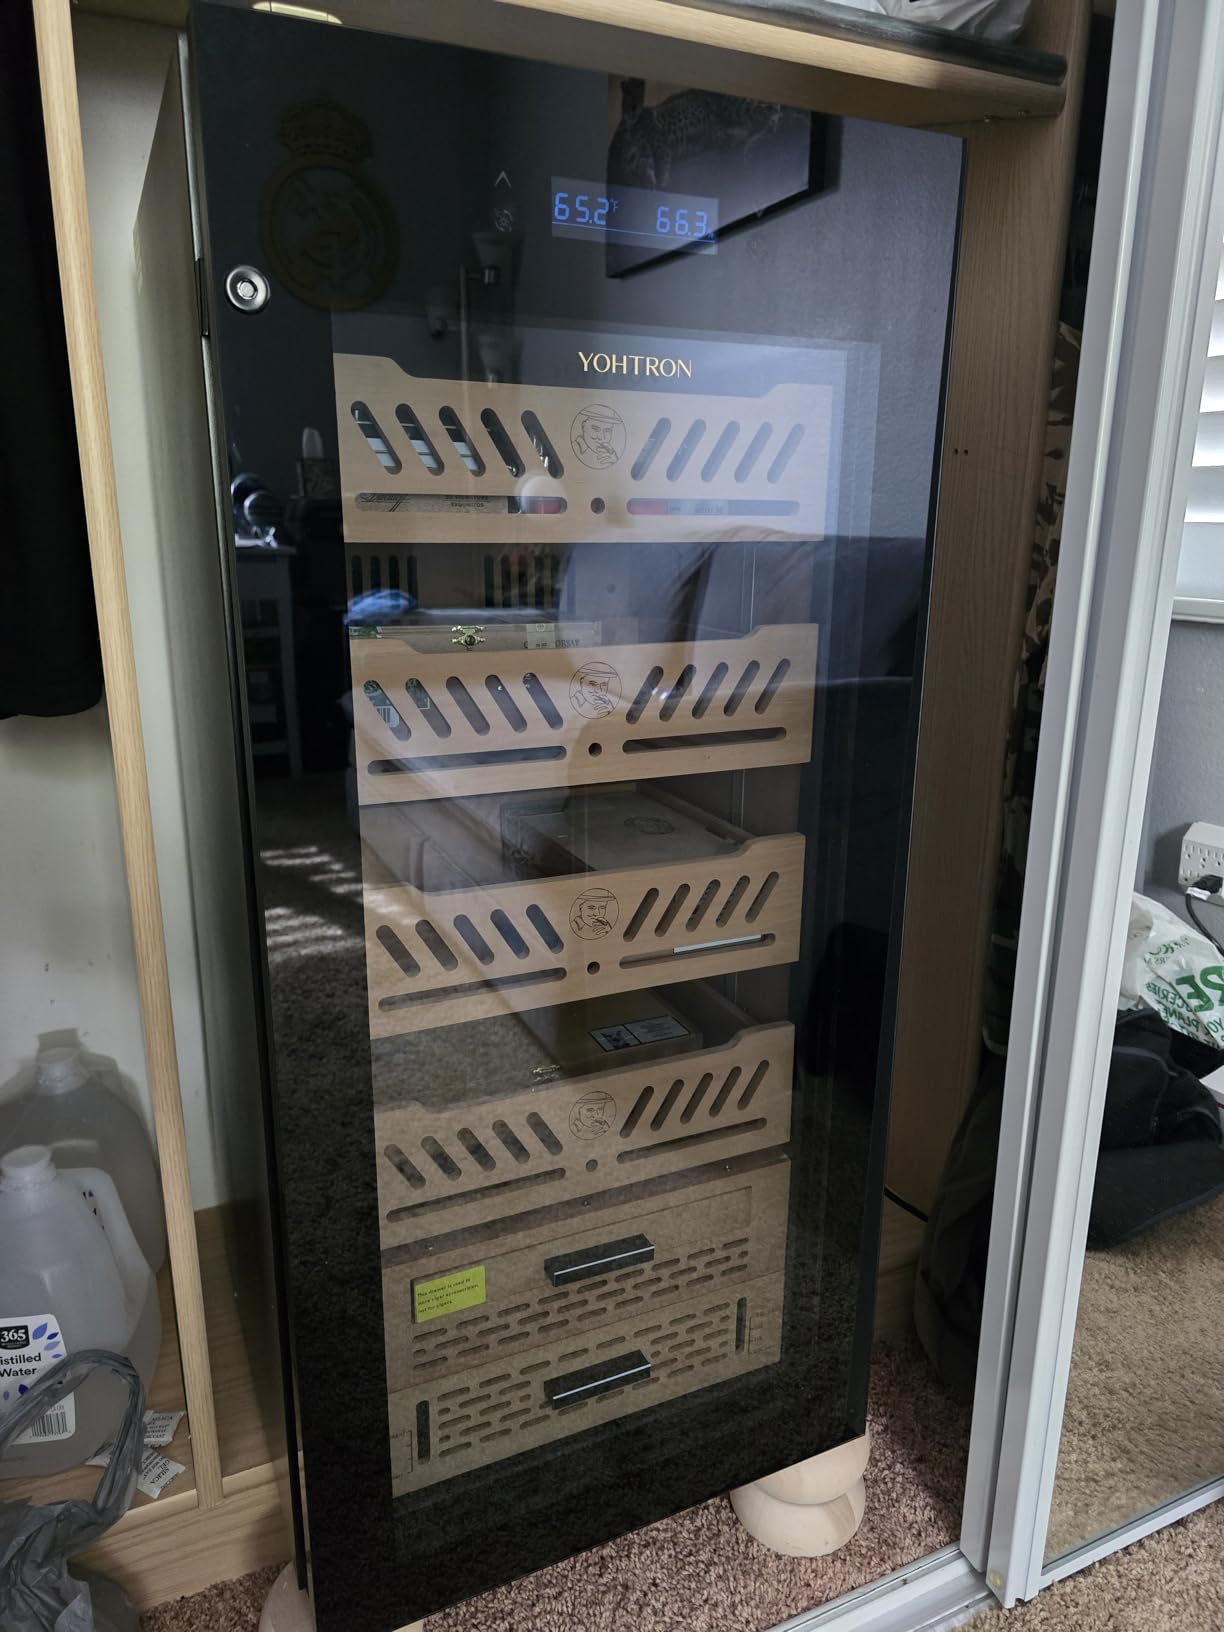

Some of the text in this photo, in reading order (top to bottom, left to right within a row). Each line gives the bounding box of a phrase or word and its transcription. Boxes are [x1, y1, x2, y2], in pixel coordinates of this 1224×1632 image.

[578, 351, 692, 379] YOHTRON
[1, 1328, 26, 1343] 365
[0, 1352, 42, 1366] istilled
[0, 1367, 37, 1378] Water
[150, 1467, 170, 1484] SILICA
